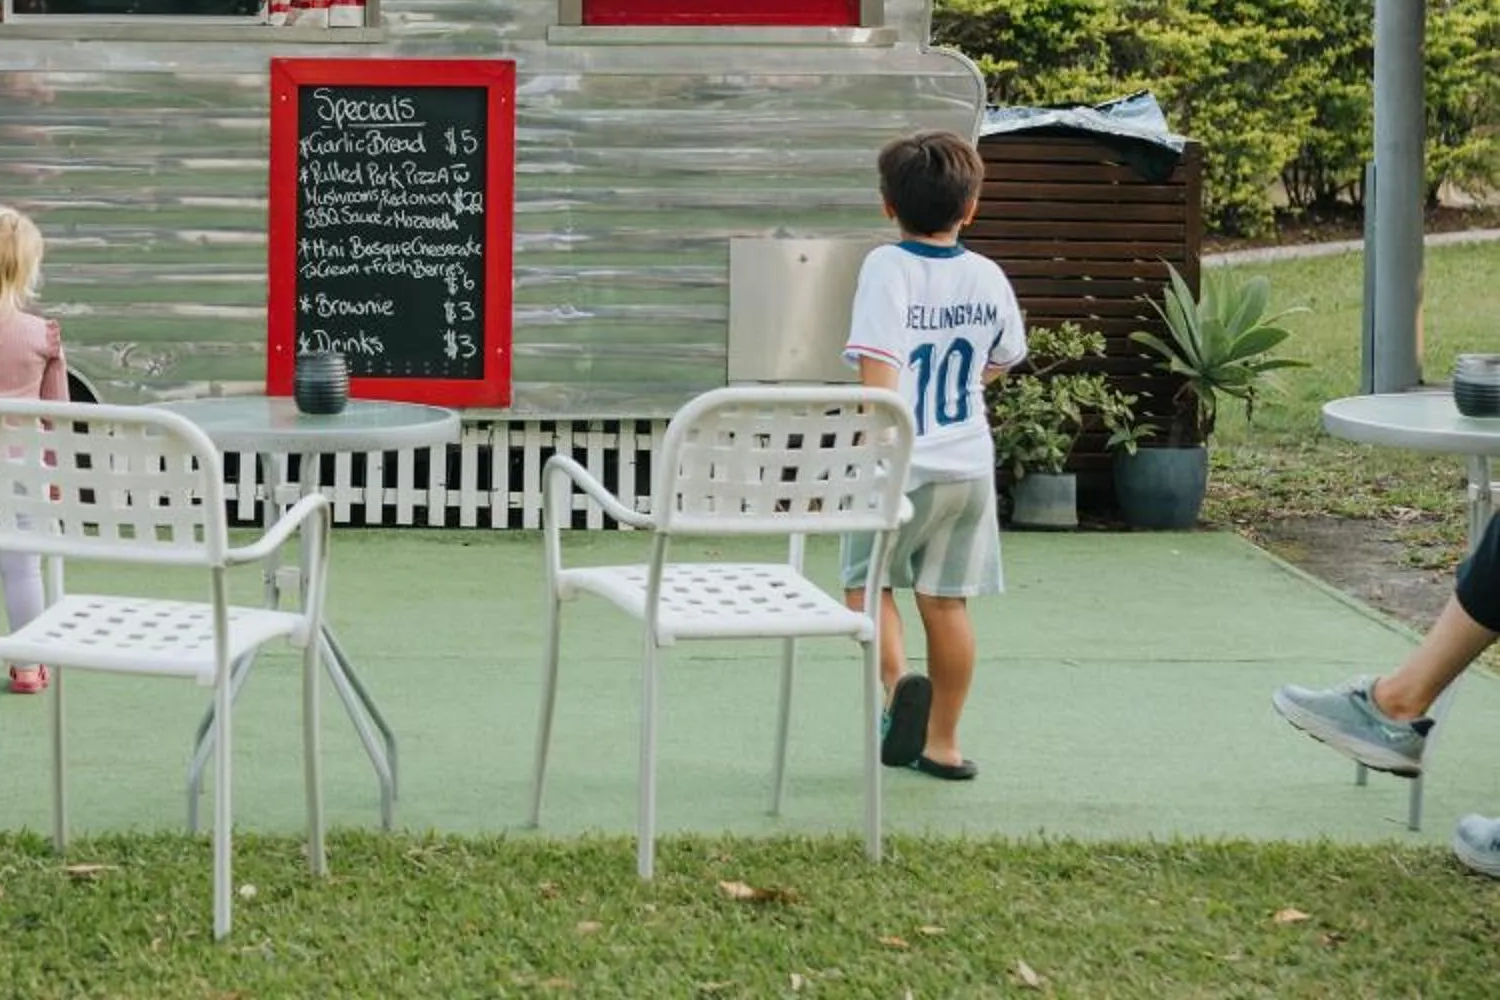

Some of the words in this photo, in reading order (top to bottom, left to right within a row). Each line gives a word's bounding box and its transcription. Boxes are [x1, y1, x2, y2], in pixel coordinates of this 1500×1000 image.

[313, 87, 415, 130] Specials
[309, 131, 365, 155] Garlic
[365, 129, 427, 156] Bread
[443, 126, 478, 156] $5
[309, 160, 364, 185] Pulled
[367, 162, 405, 189] Pork
[317, 259, 360, 278] Cream
[442, 298, 476, 325] $3
[312, 329, 386, 356] Drinks
[442, 328, 477, 361] $3
[908, 336, 975, 437] 10
